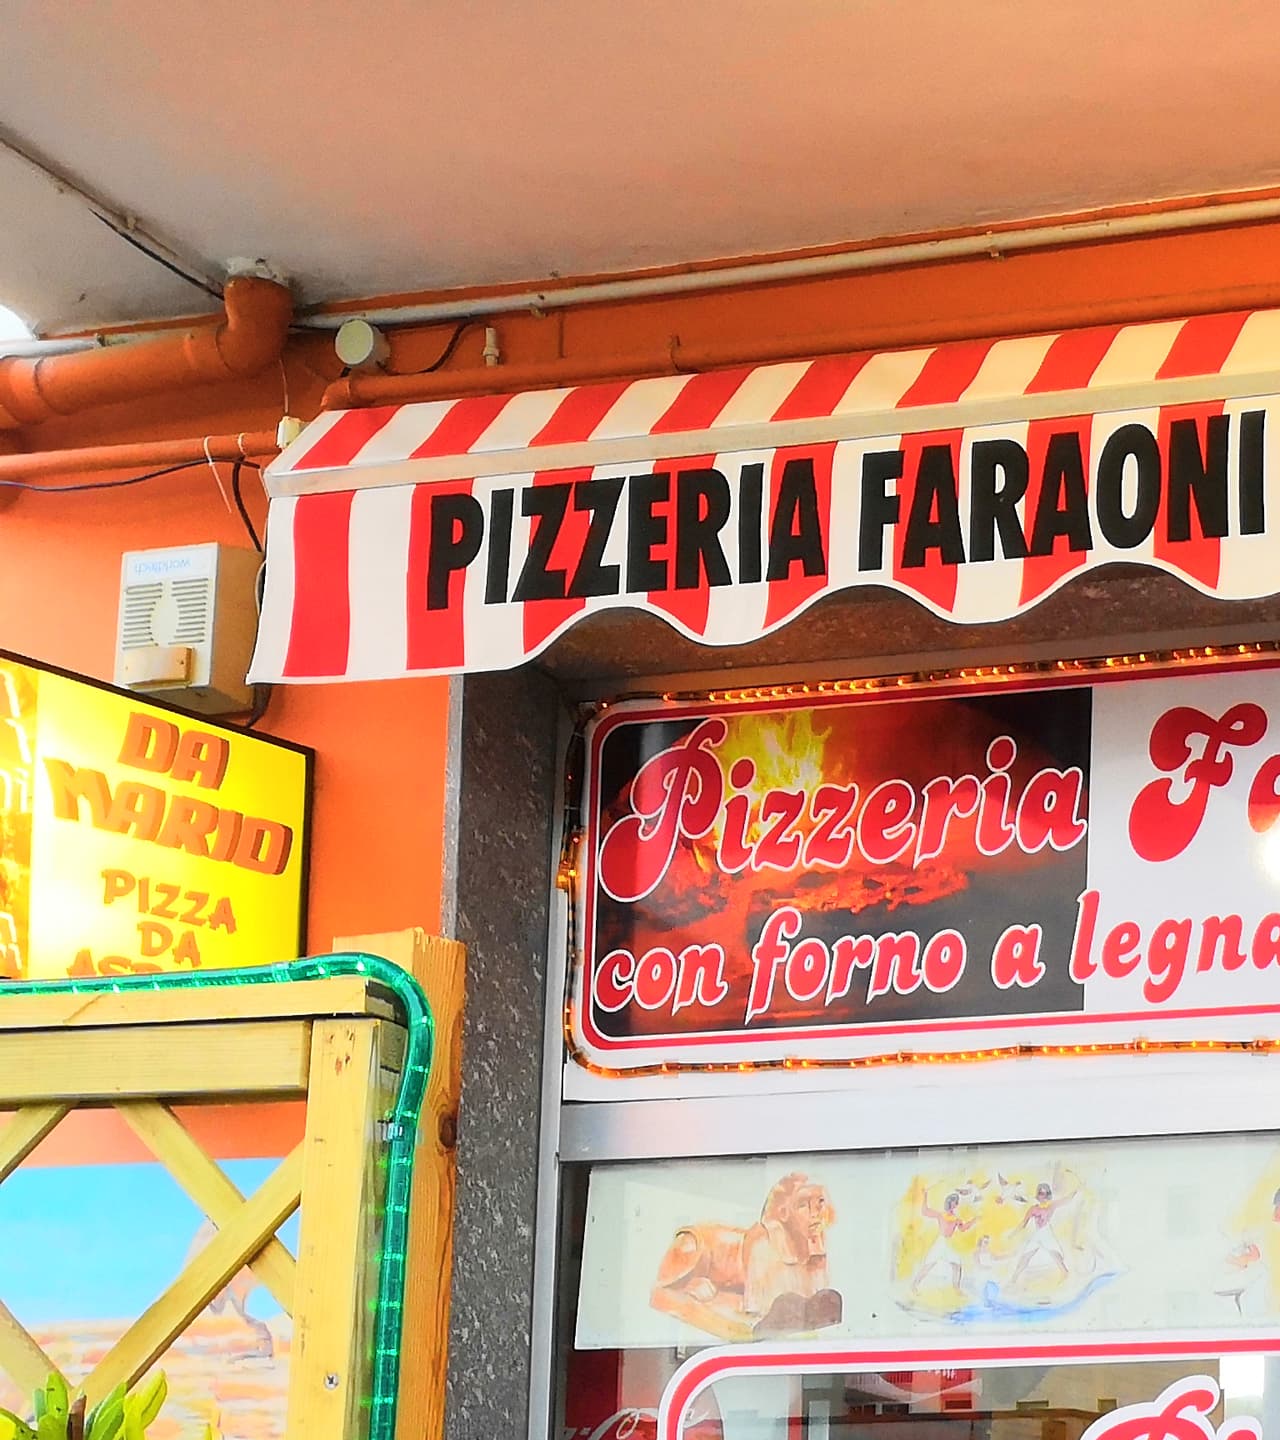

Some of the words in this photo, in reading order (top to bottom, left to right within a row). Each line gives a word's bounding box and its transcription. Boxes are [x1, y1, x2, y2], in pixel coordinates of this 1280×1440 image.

[427, 458, 826, 610] PIZZERIA
[857, 409, 1267, 571] FARAONI
[117, 712, 230, 790] DA
[598, 717, 1089, 903] Pizzeria
[43, 756, 293, 875] MARIO
[101, 869, 237, 934] PIZZA
[137, 921, 201, 968] DA
[592, 942, 728, 1017] con
[745, 905, 968, 1025] forno
[991, 922, 1044, 990] a
